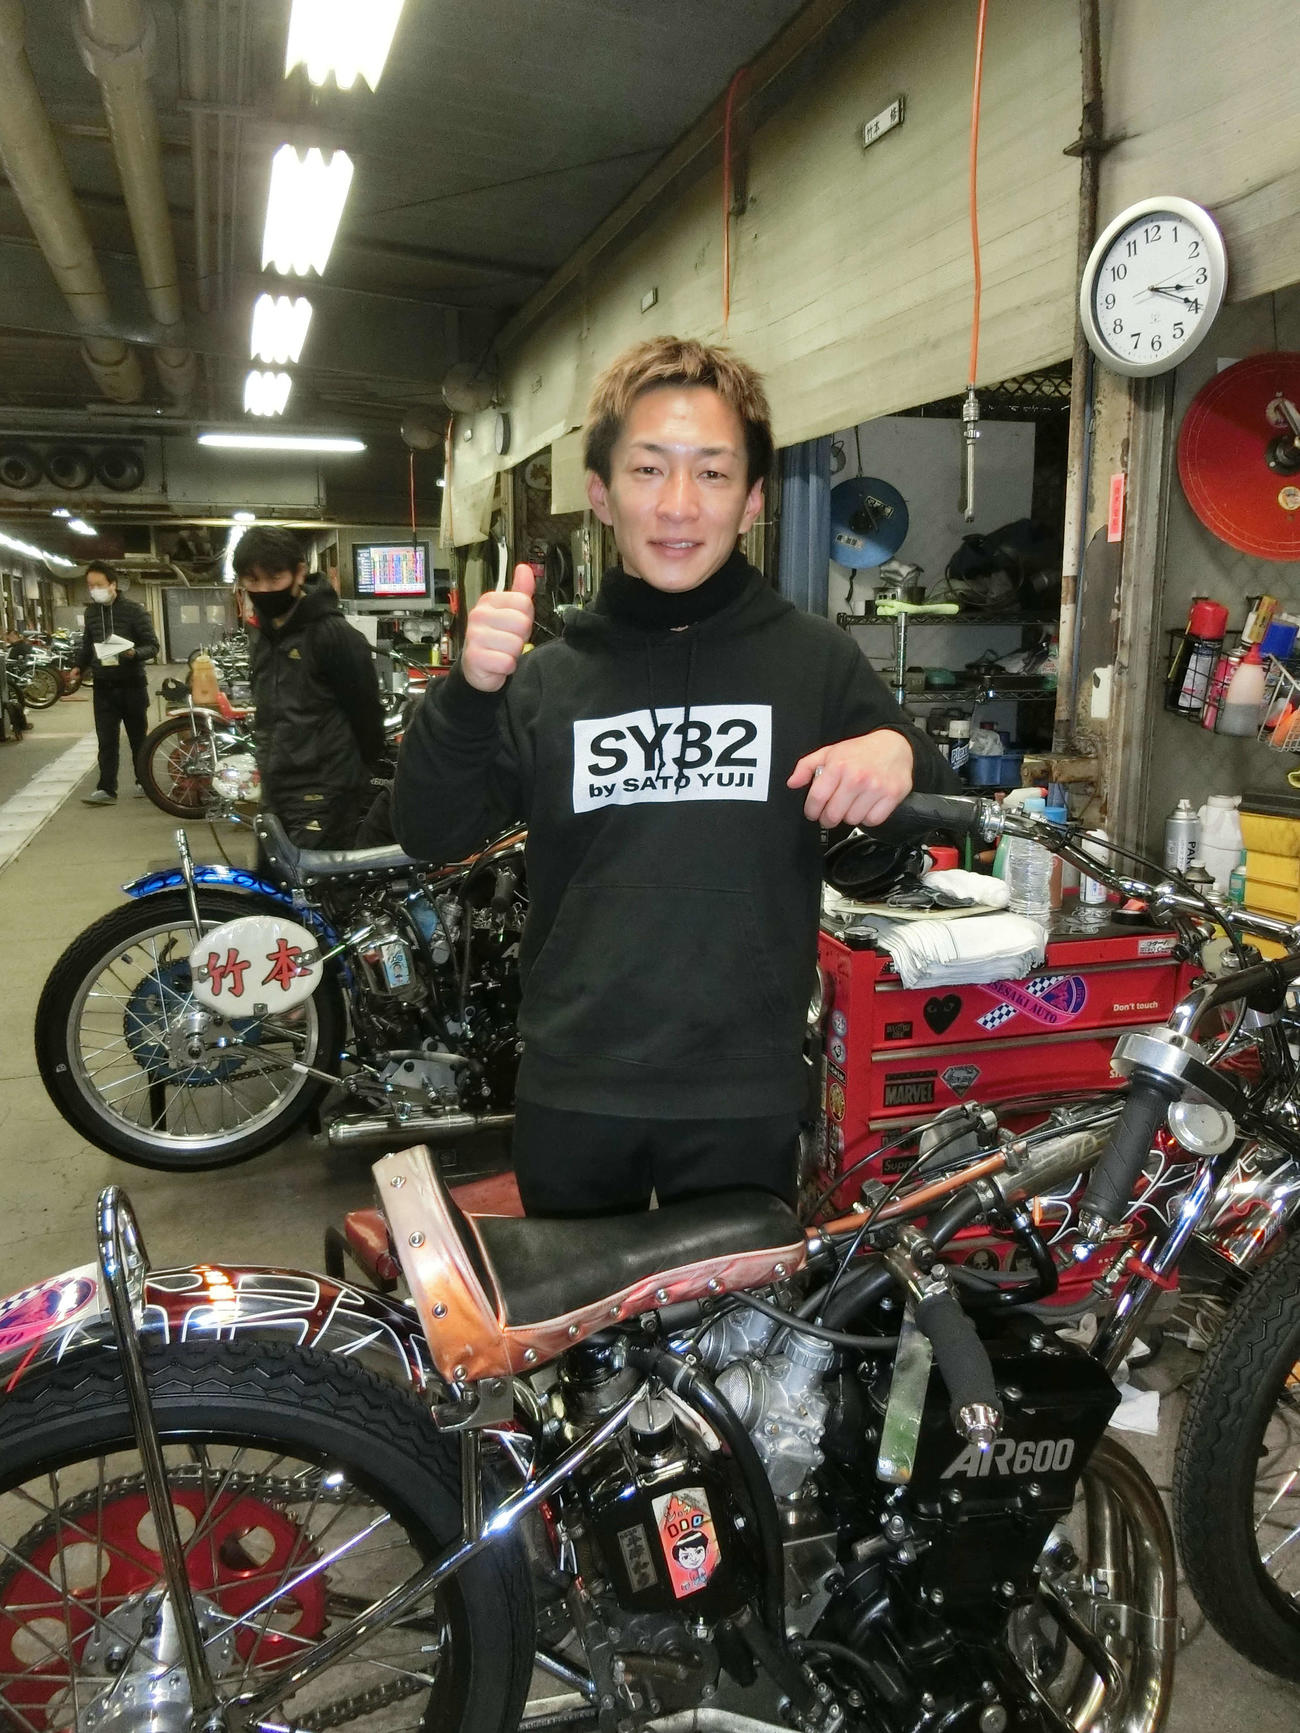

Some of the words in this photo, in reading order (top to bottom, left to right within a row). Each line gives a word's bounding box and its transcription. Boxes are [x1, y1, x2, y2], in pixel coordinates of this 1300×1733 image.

[1143, 224, 1162, 244] 12
[1172, 225, 1178, 243] 1
[1126, 239, 1138, 259] 11
[1188, 241, 1200, 259] 2
[1110, 263, 1127, 282] 10
[1195, 267, 1208, 285] 3
[1105, 293, 1116, 310] 9
[1187, 298, 1201, 315] 4
[1112, 318, 1124, 335] 8
[1172, 322, 1185, 340] 5
[1130, 332, 1142, 350] 7
[1151, 335, 1162, 351] 6
[588, 782, 616, 798] by
[622, 775, 691, 792] SATO
[697, 772, 754, 788] YUJI
[207, 938, 313, 998] 竹本
[1029, 1003, 1058, 1024] AUTO
[1113, 1003, 1135, 1012] Don't
[1136, 1001, 1159, 1010] touch
[885, 1082, 933, 1107] MARVEL
[939, 1438, 1075, 1479] AR600
